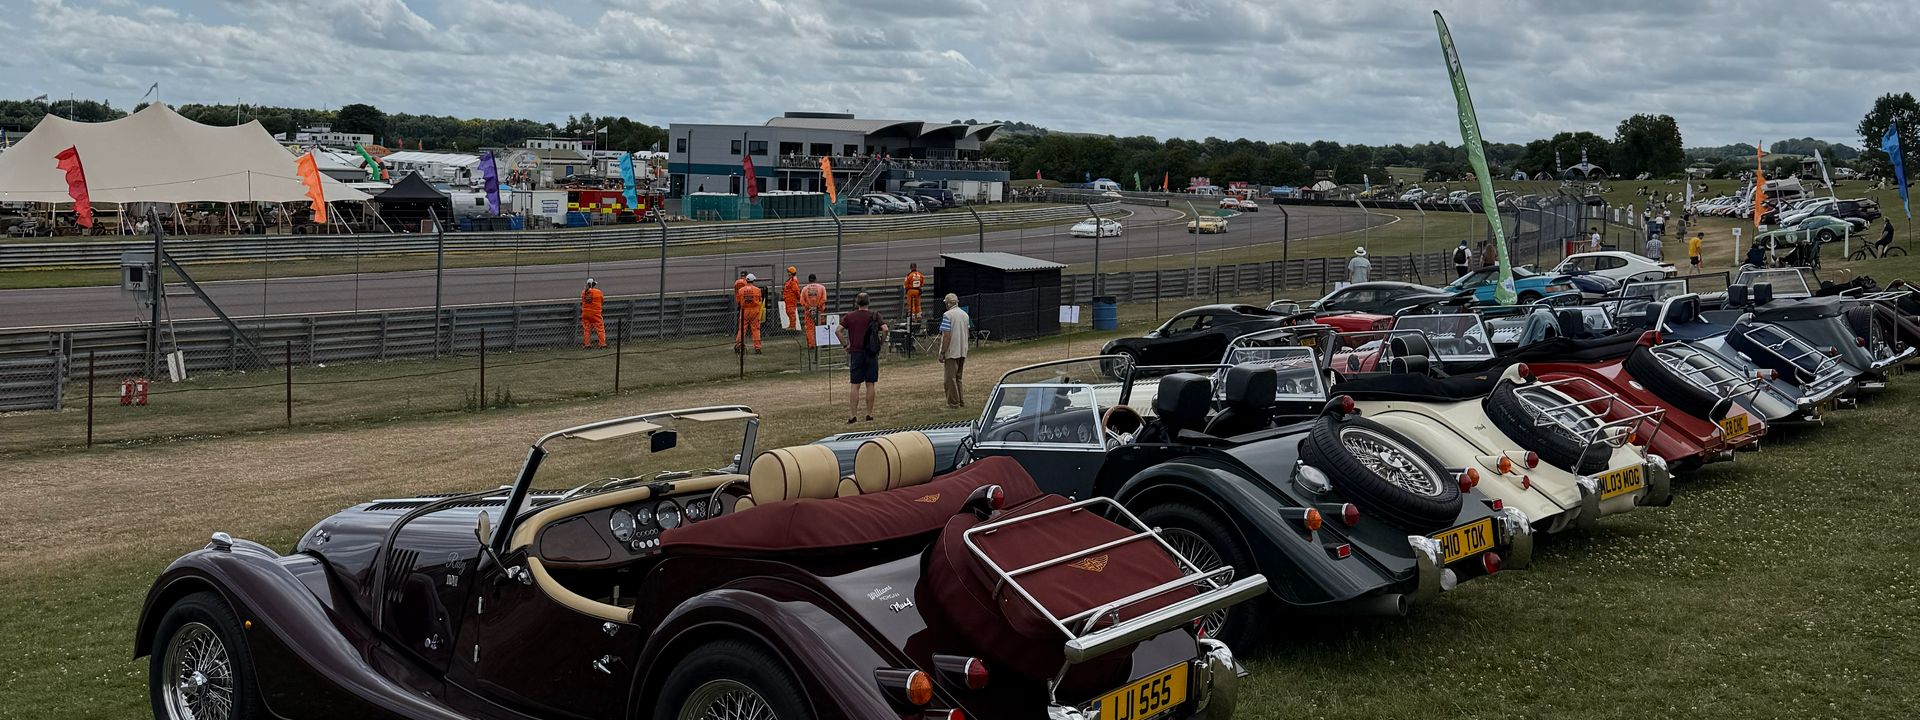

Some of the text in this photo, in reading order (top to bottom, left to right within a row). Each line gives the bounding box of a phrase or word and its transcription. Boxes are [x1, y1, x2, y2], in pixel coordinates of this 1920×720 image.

[1623, 467, 1640, 488] MOG
[1464, 524, 1486, 551] TOK
[1139, 674, 1171, 715] 555
